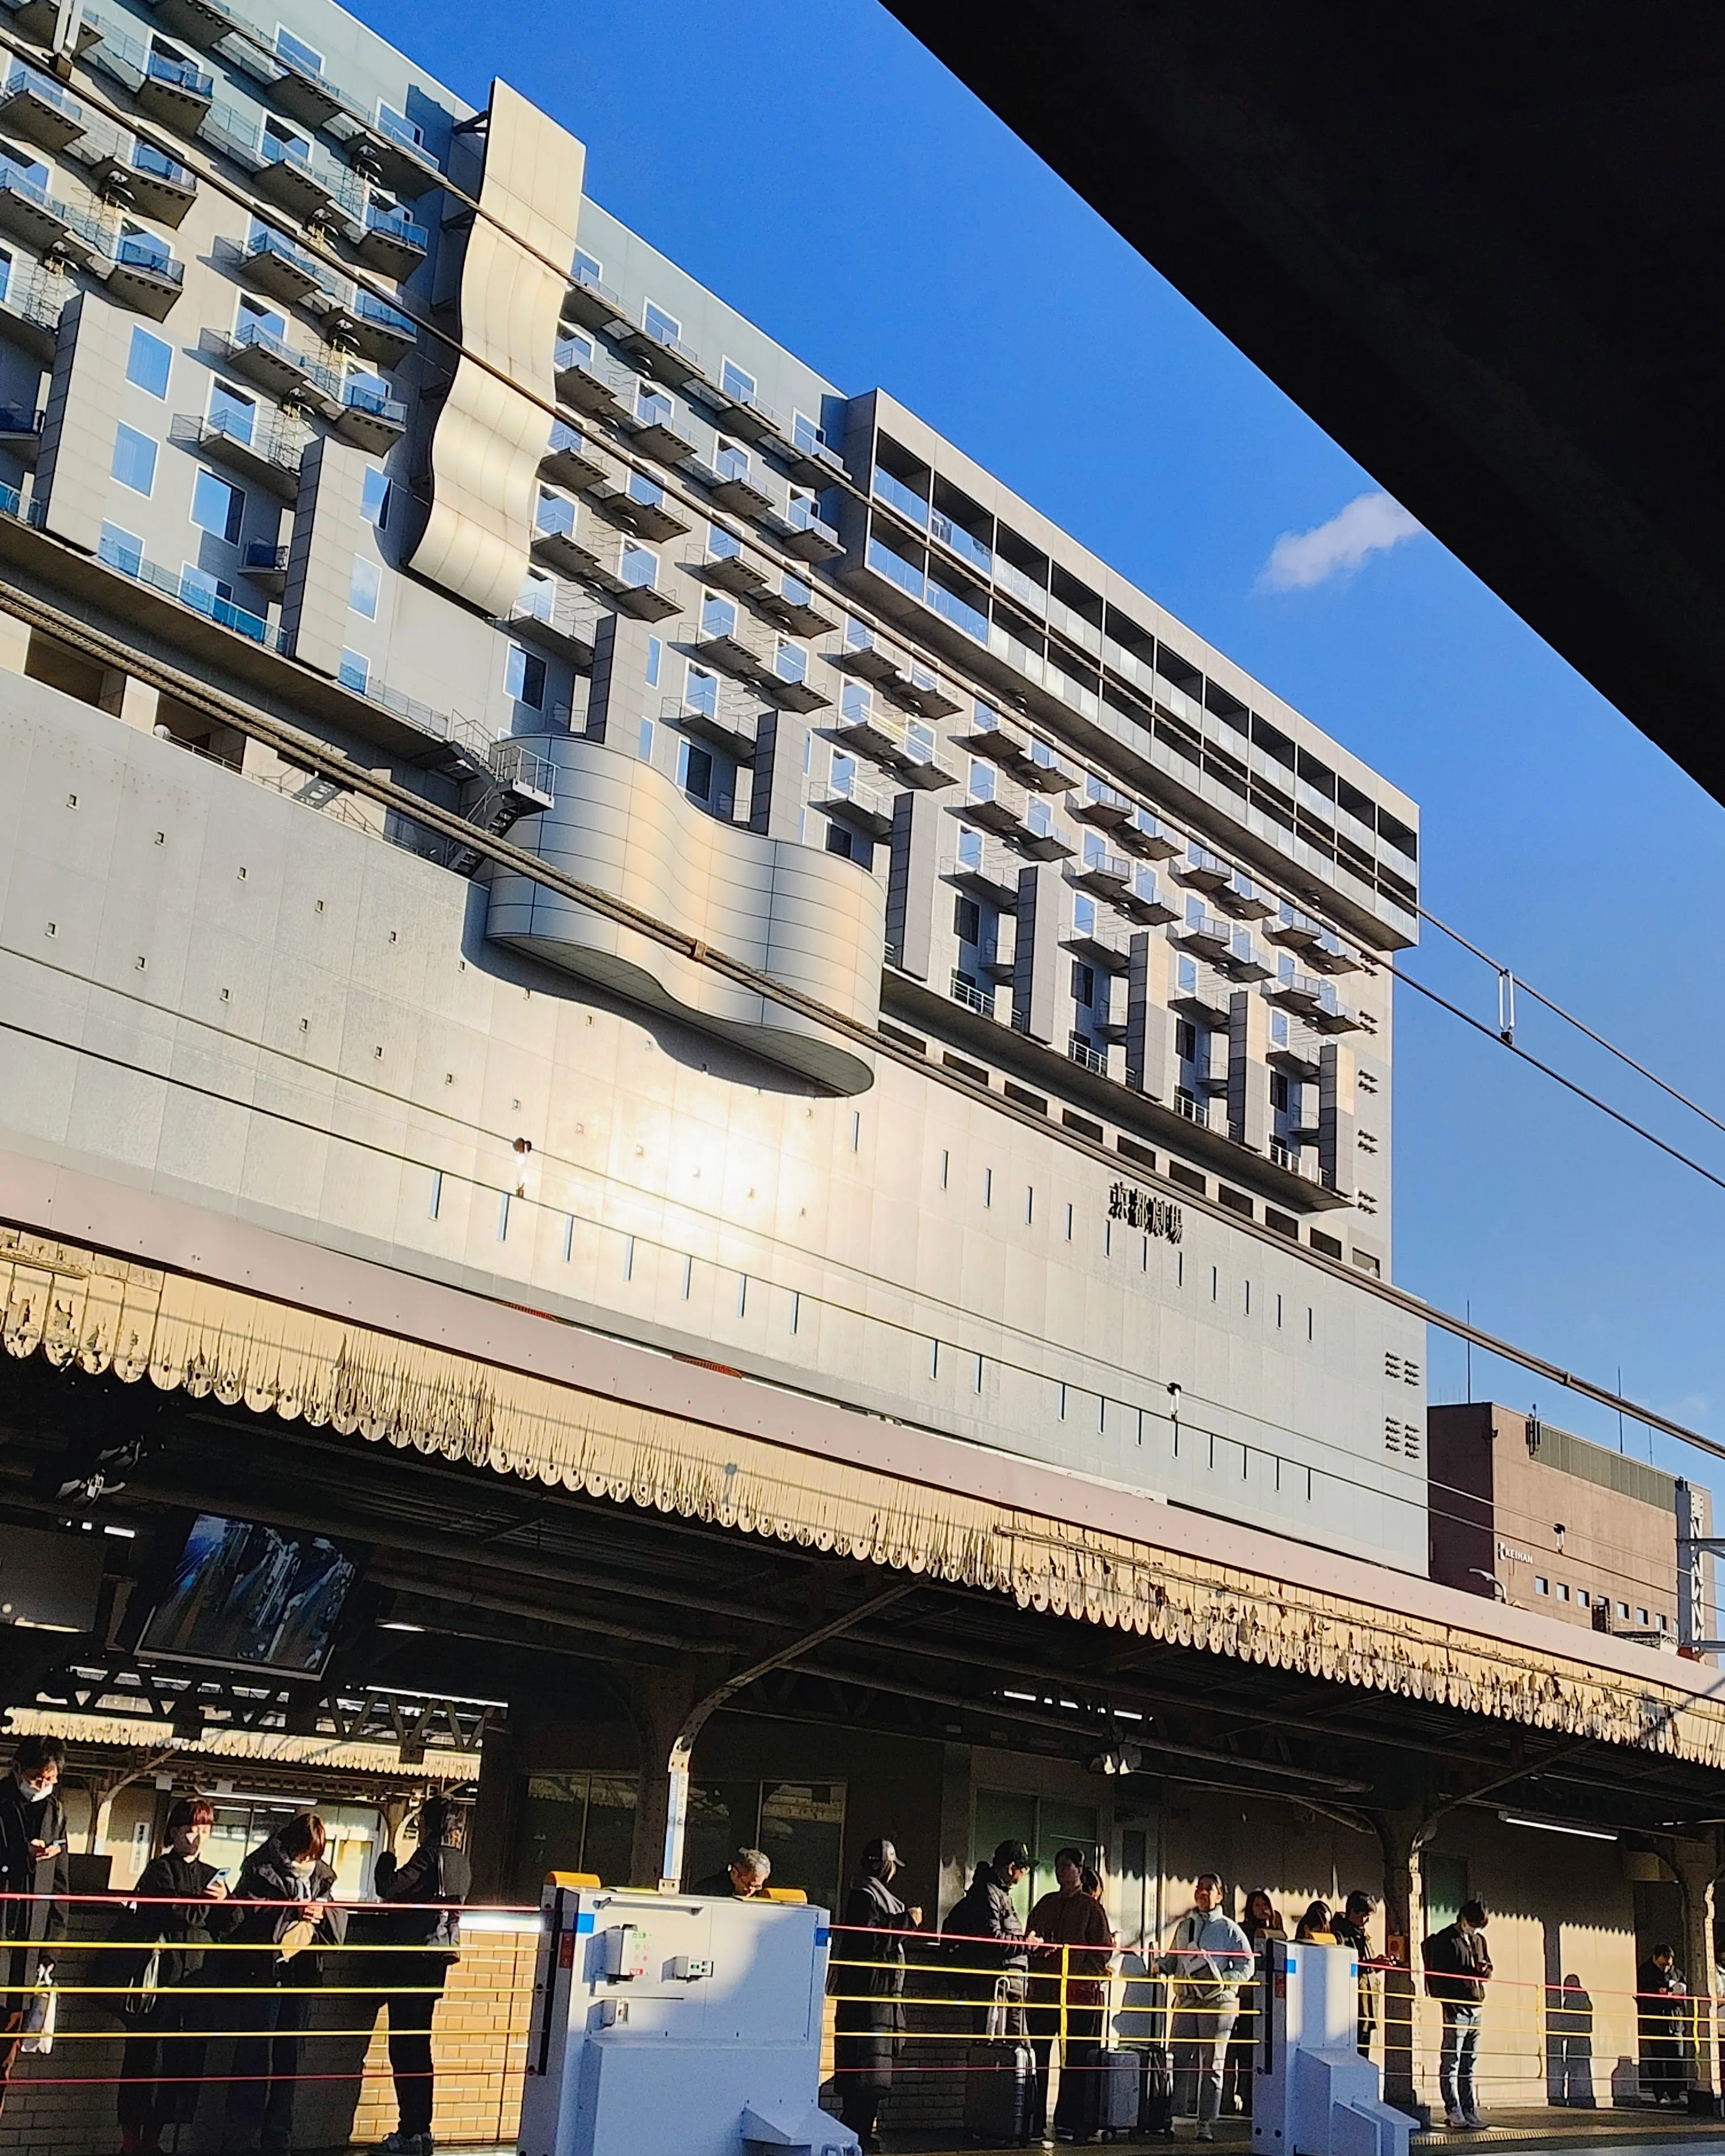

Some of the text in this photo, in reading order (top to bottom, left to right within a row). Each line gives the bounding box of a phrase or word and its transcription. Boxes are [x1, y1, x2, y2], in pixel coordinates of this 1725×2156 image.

[1108, 1182, 1183, 1244] 京都劇場
[1505, 1548, 1533, 1564] KEIHAN
